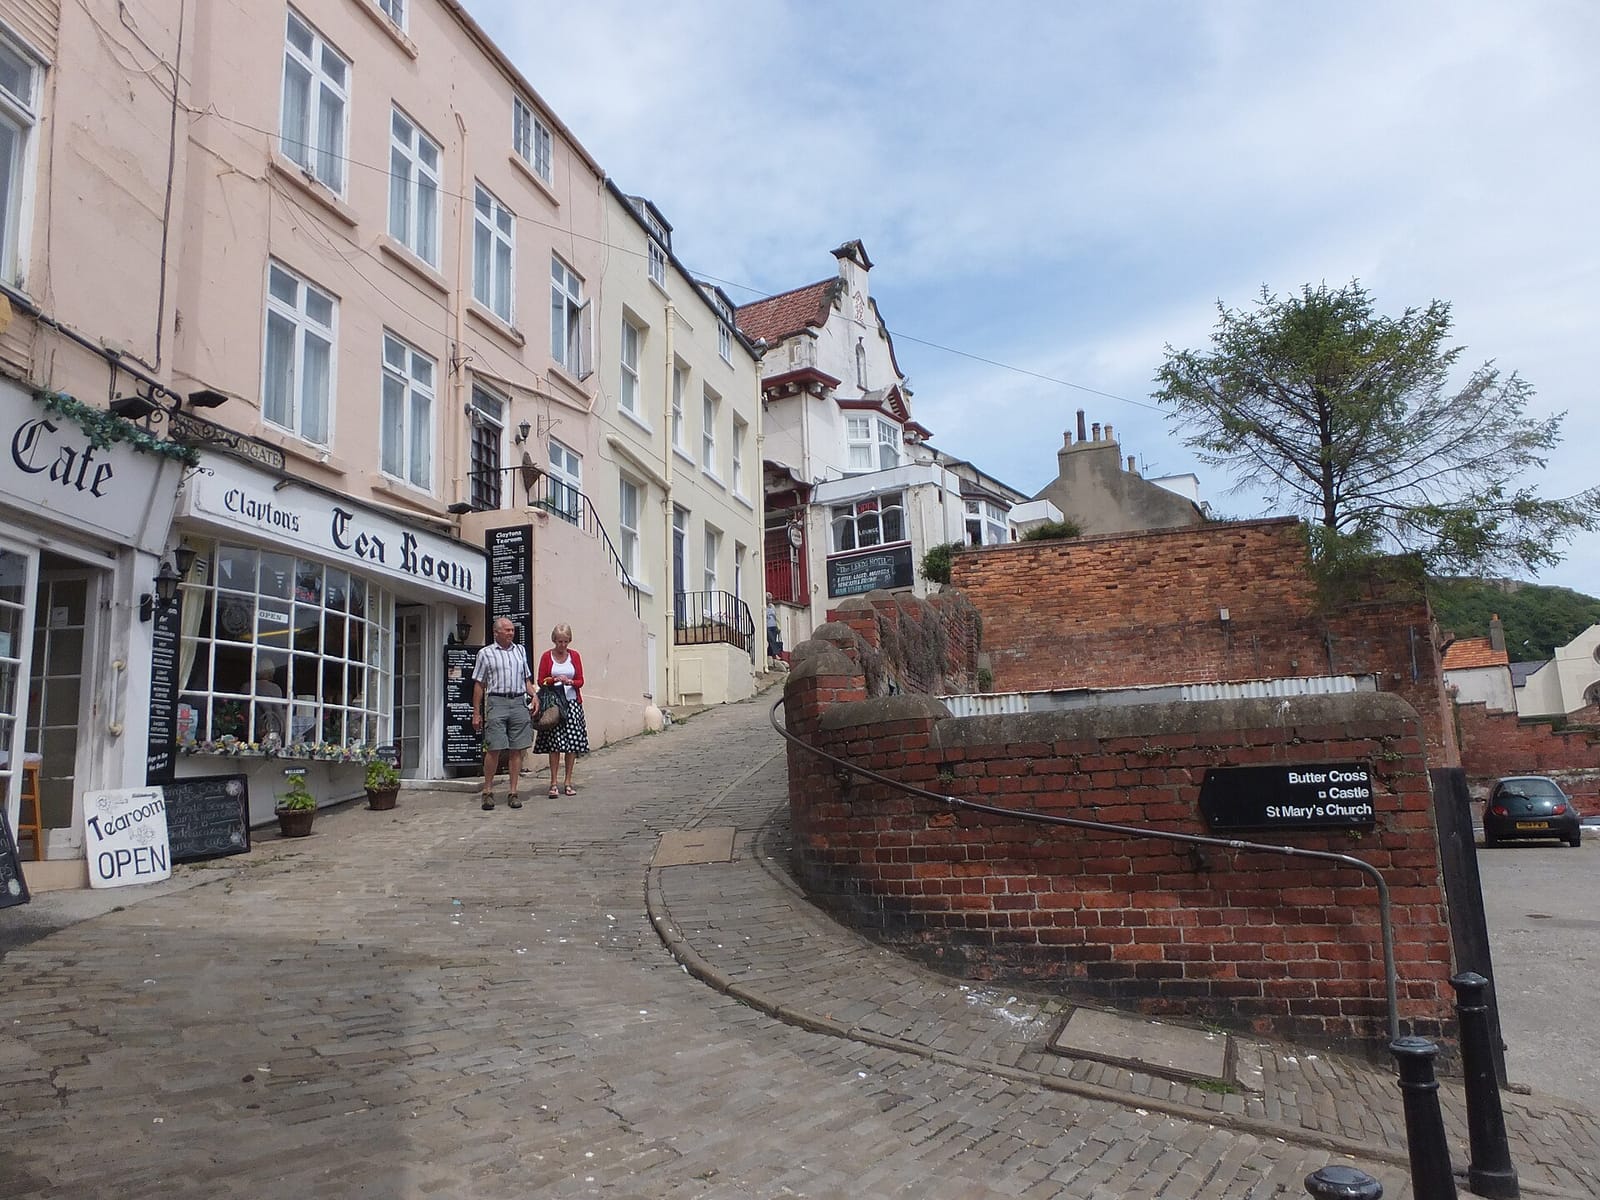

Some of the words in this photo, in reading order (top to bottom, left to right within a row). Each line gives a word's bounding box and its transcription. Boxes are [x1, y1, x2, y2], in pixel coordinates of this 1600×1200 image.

[11, 418, 113, 498] Cafe
[224, 489, 300, 532] Clayton's
[331, 507, 385, 563] Tea
[400, 532, 472, 591] Room
[260, 611, 282, 620] OPEN
[1288, 772, 1327, 784] Butter
[1329, 770, 1368, 782] Cross
[1329, 787, 1369, 799] Castle
[88, 800, 165, 841] Tearoom
[1266, 805, 1281, 817] St
[1282, 804, 1324, 819] Mary's
[1326, 804, 1372, 817] Church
[98, 844, 167, 880] OPEN
